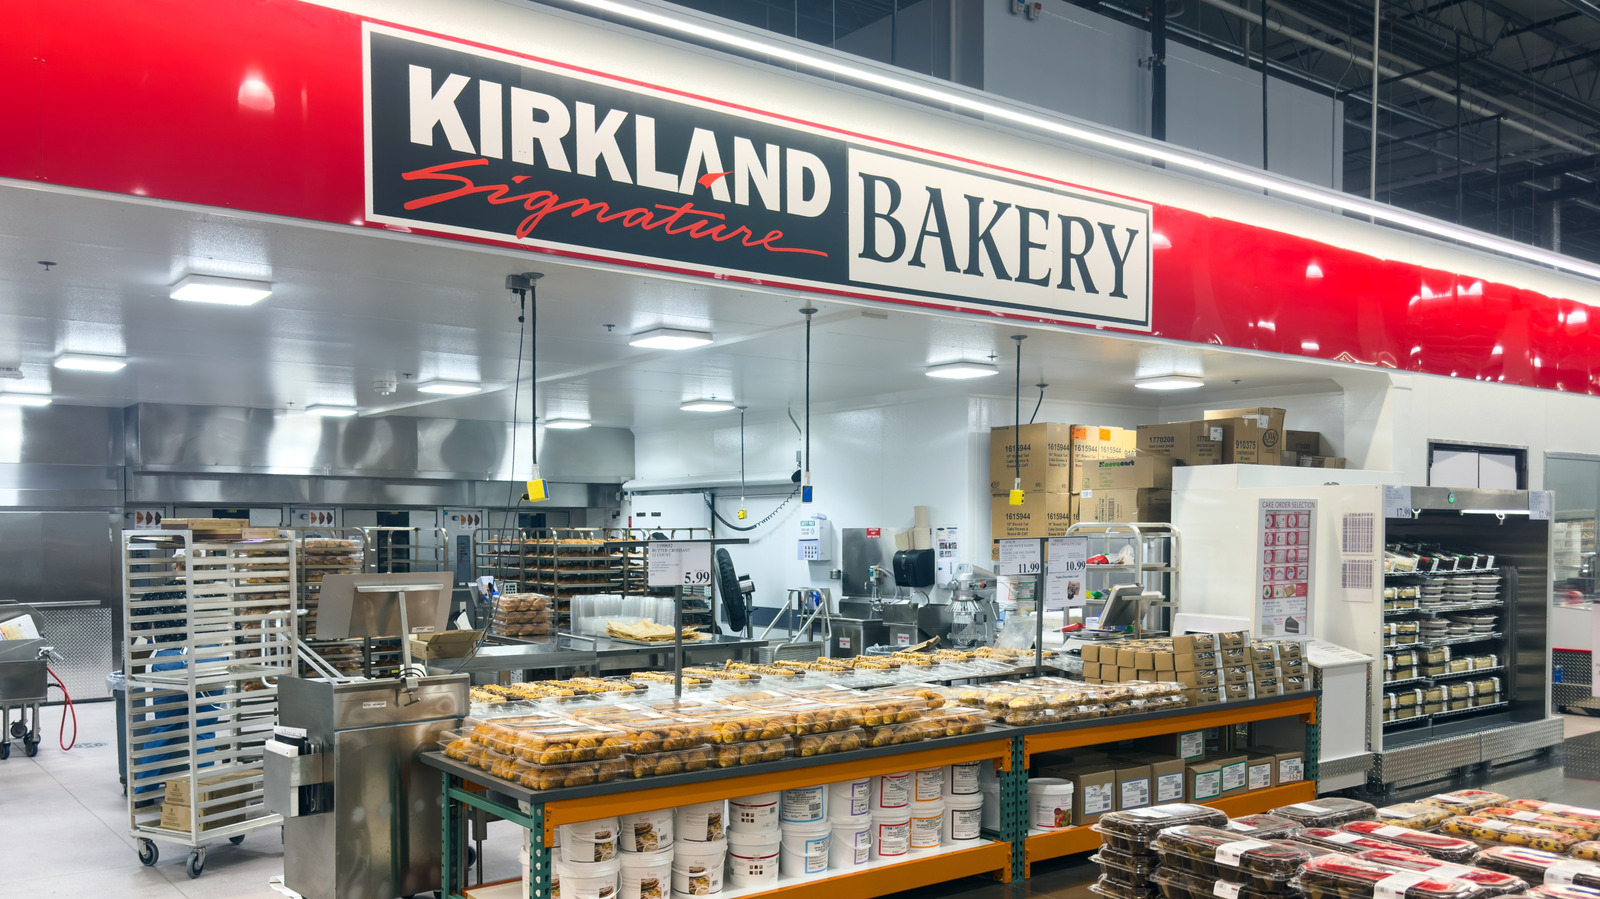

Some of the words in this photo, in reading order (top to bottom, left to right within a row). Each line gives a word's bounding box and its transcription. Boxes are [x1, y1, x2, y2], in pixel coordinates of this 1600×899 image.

[409, 64, 831, 218] KIRKLAND
[402, 158, 829, 258] Signature
[858, 172, 1139, 300] BAKERY
[1047, 443, 1070, 451] 1615944
[1074, 444, 1098, 452] 1615944
[1235, 440, 1257, 449] 910375
[1005, 512, 1031, 520] 1615944
[1047, 512, 1069, 520] 1615944
[1018, 562, 1040, 573] 11.99
[1066, 560, 1086, 571] 10.99
[684, 571, 710, 584] 5.99
